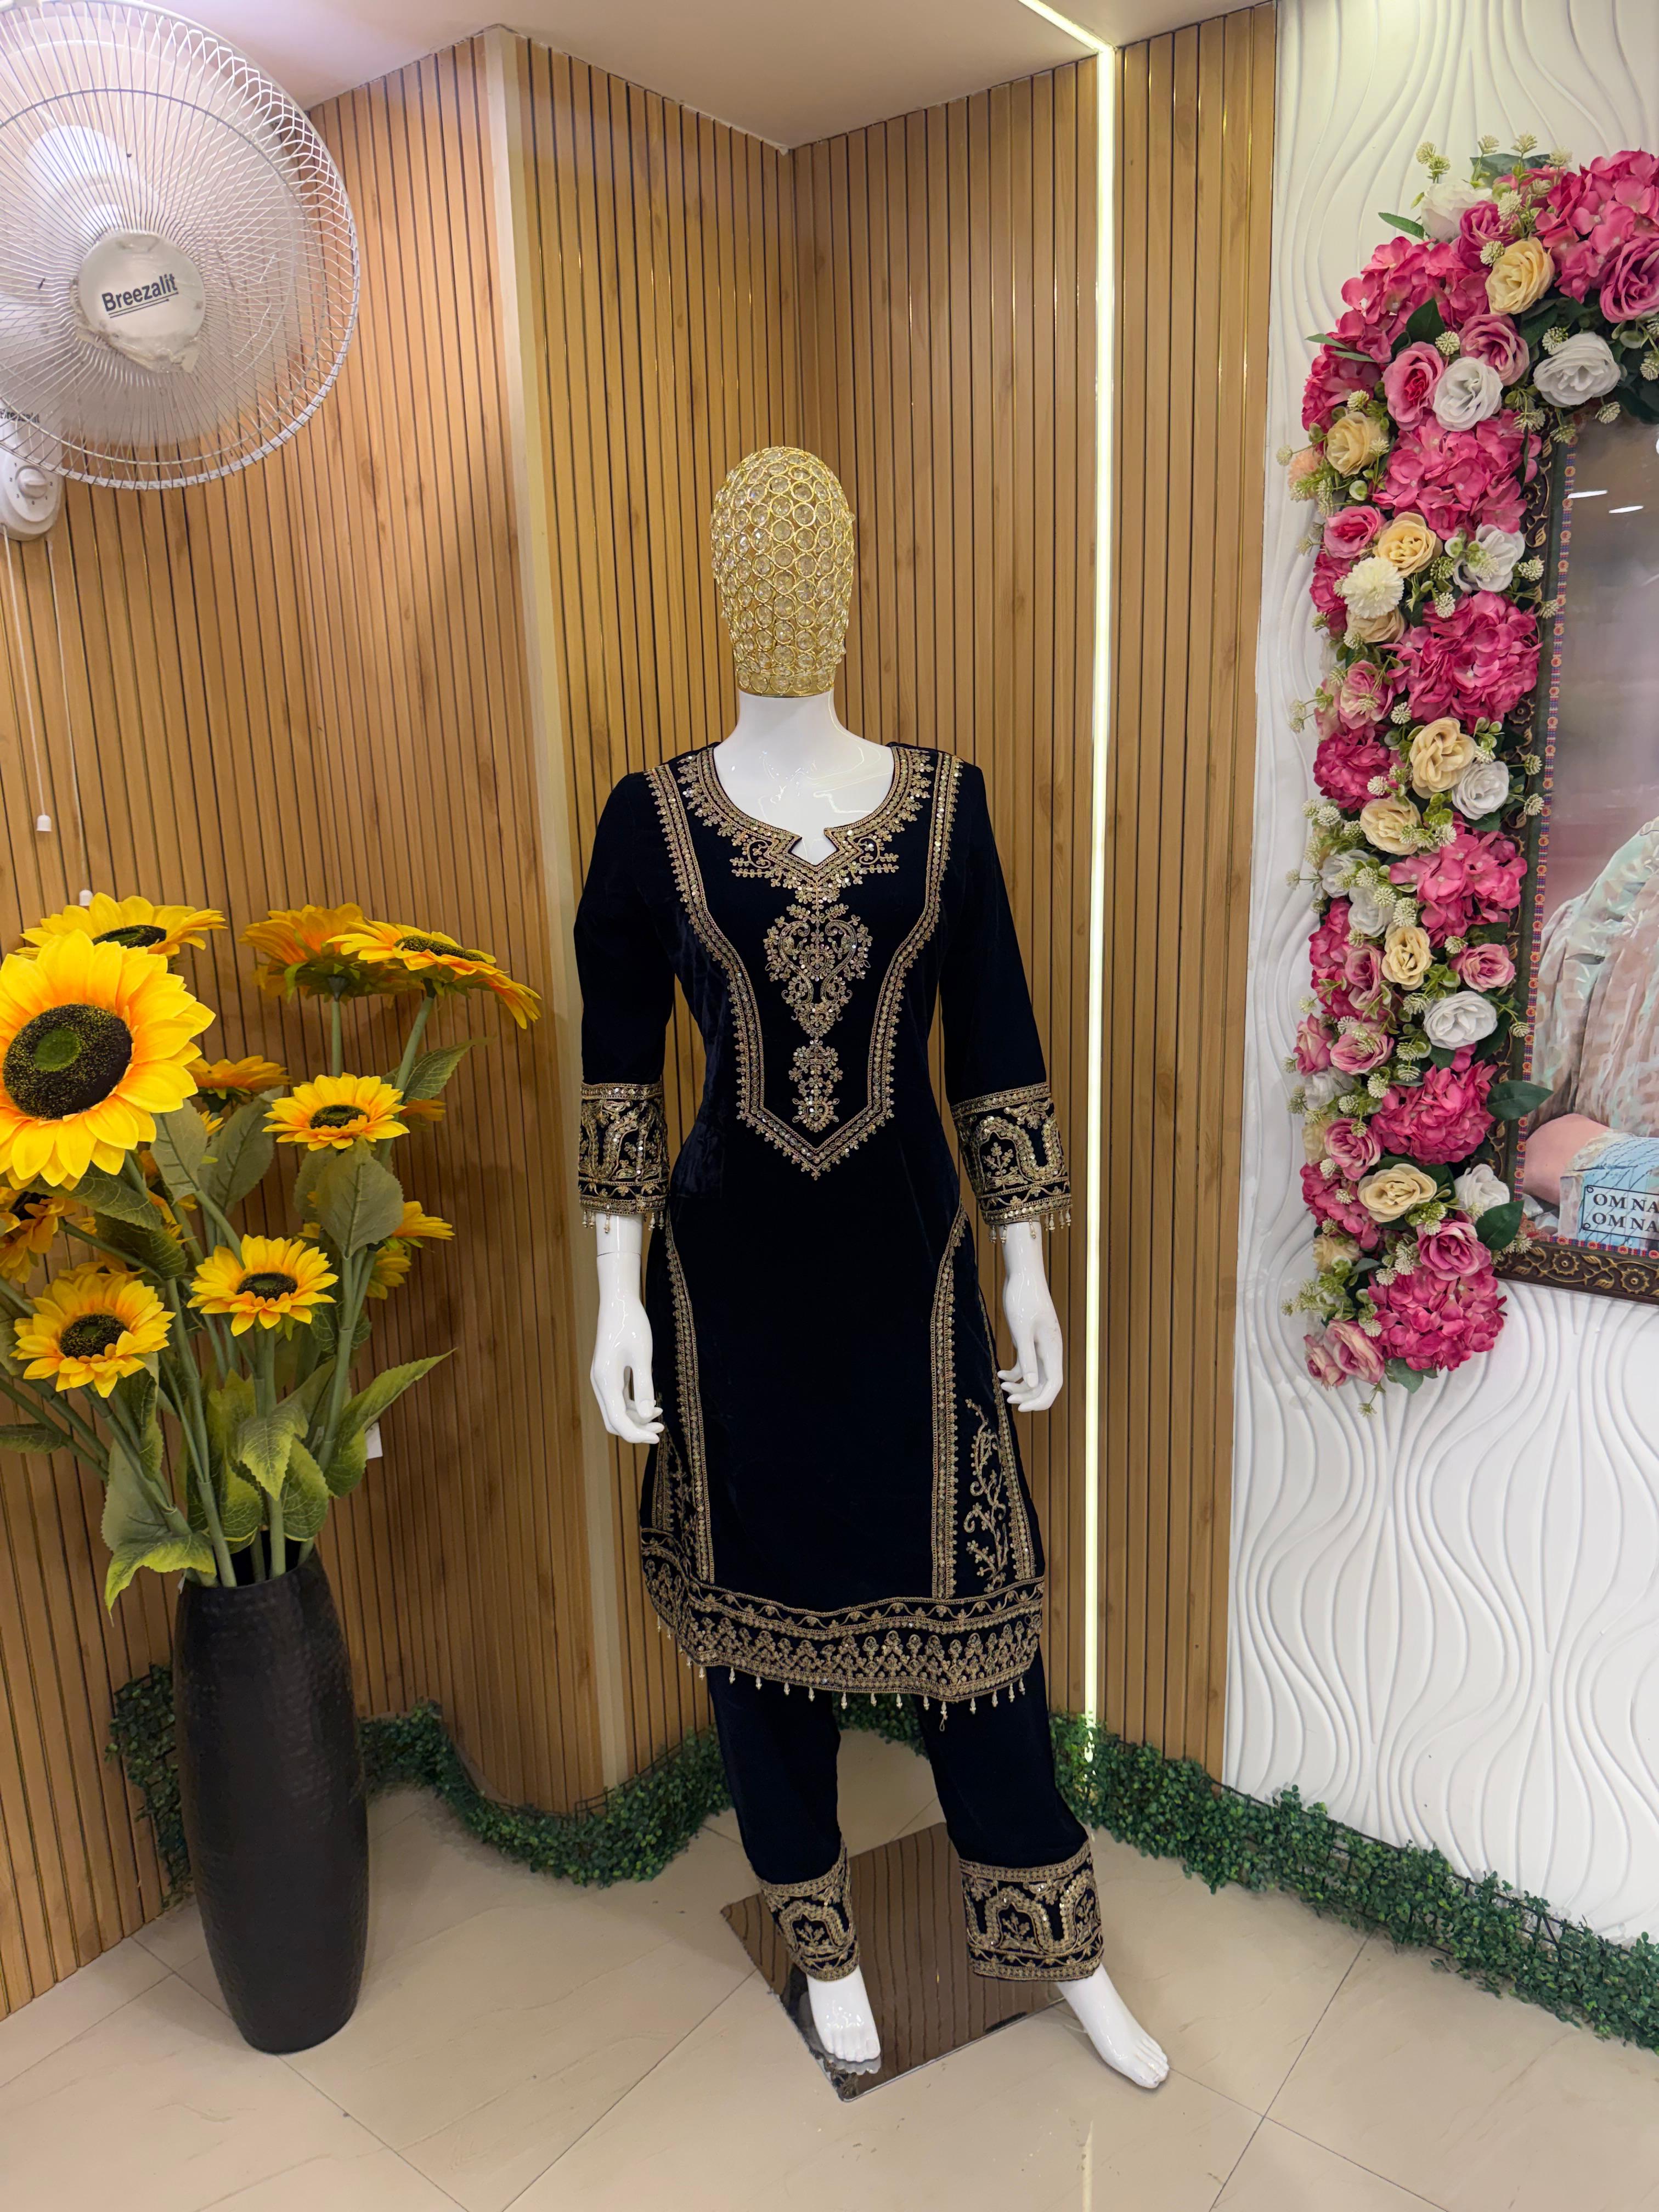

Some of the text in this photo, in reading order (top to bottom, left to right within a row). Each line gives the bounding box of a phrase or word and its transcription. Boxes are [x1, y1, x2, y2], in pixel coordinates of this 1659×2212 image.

[101, 273, 177, 312] Breezalit
[1593, 1193, 1627, 1209] OM
[1592, 1212, 1626, 1228] OM
